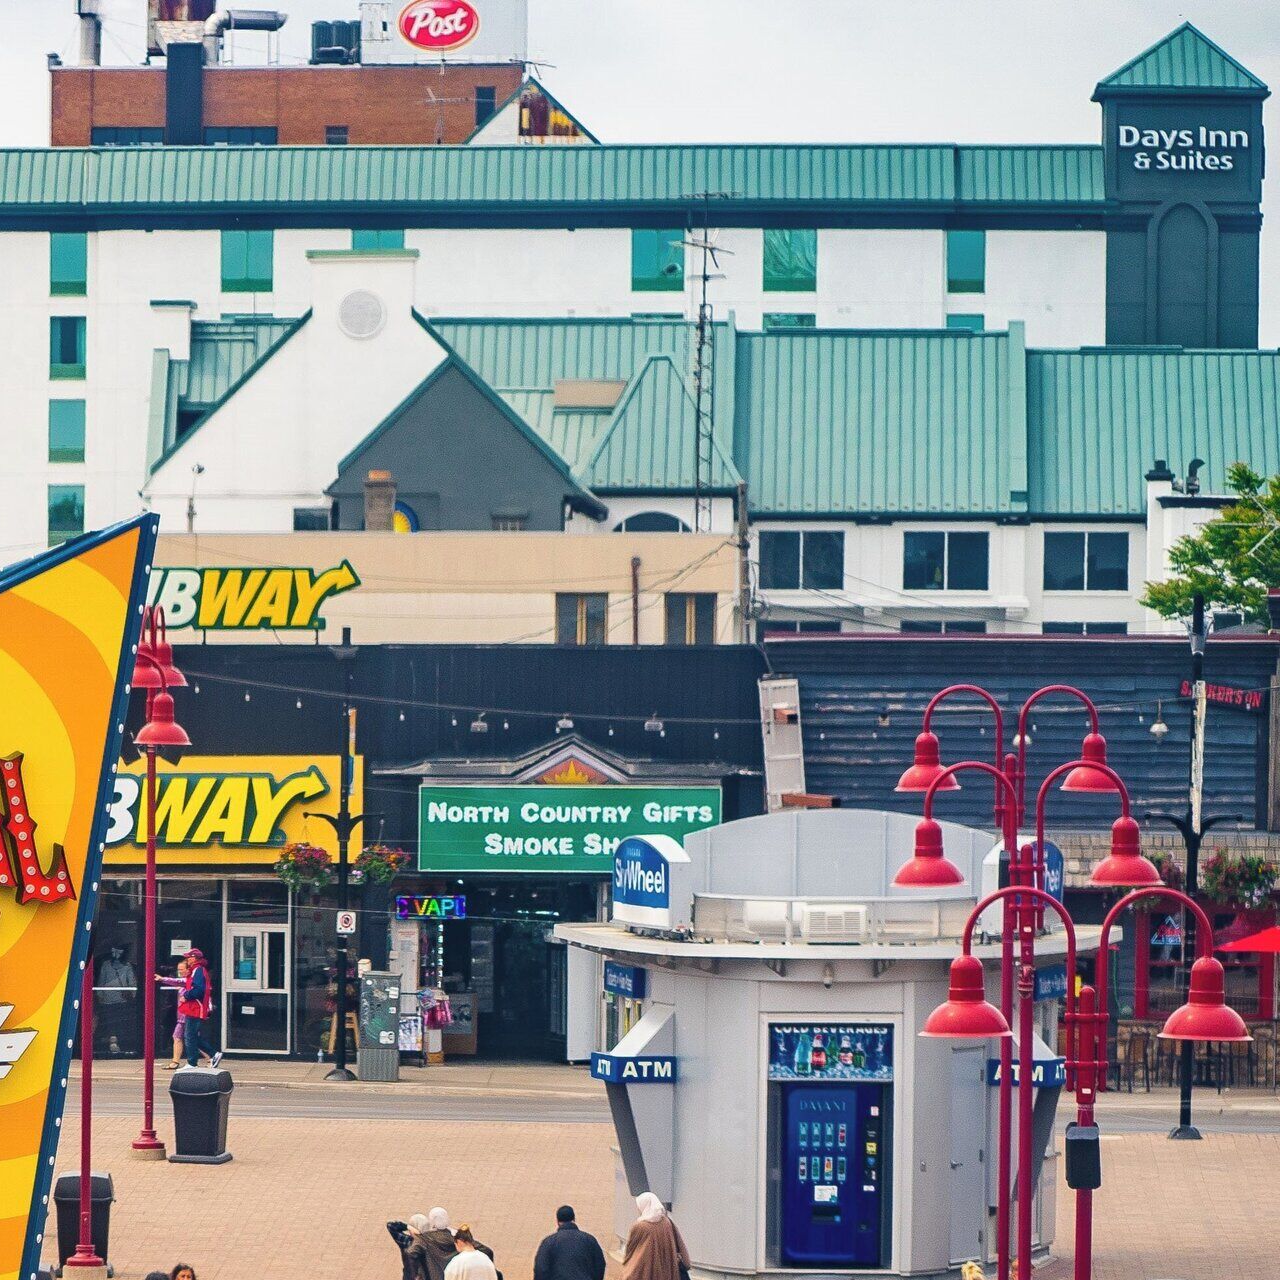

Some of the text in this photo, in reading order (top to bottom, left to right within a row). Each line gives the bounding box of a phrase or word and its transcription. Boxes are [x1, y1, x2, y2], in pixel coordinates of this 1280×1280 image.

[408, 7, 469, 39] Post
[1119, 125, 1249, 150] Days Inn
[1134, 150, 1234, 171] & Suites
[427, 801, 713, 824] NORTH COUNTRY GIFTS
[484, 832, 620, 856] SMOKE SH
[615, 857, 666, 896] SkyWheel
[622, 1061, 672, 1078] ATM
